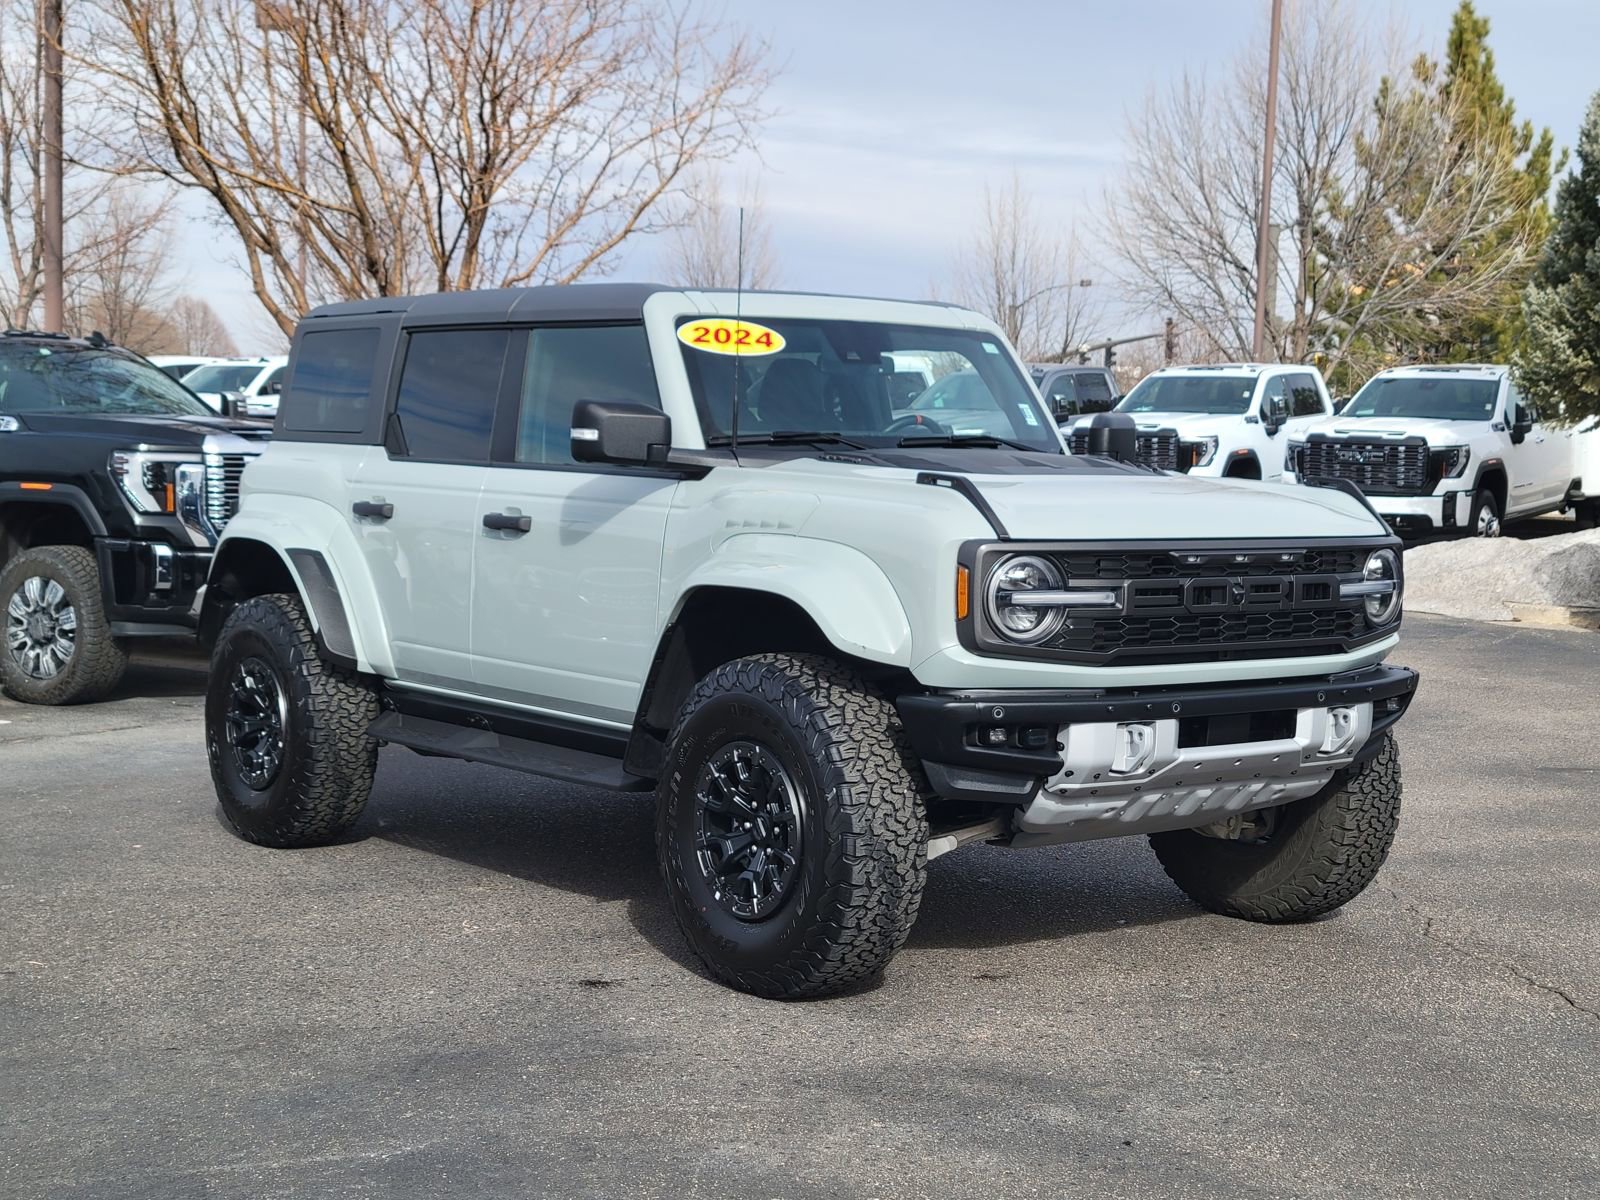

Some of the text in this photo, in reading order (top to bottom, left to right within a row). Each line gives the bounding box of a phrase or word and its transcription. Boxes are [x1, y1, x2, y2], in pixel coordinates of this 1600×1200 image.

[692, 326, 773, 348] 2024
[1337, 450, 1385, 463] GMC
[1125, 574, 1341, 616] FORD
